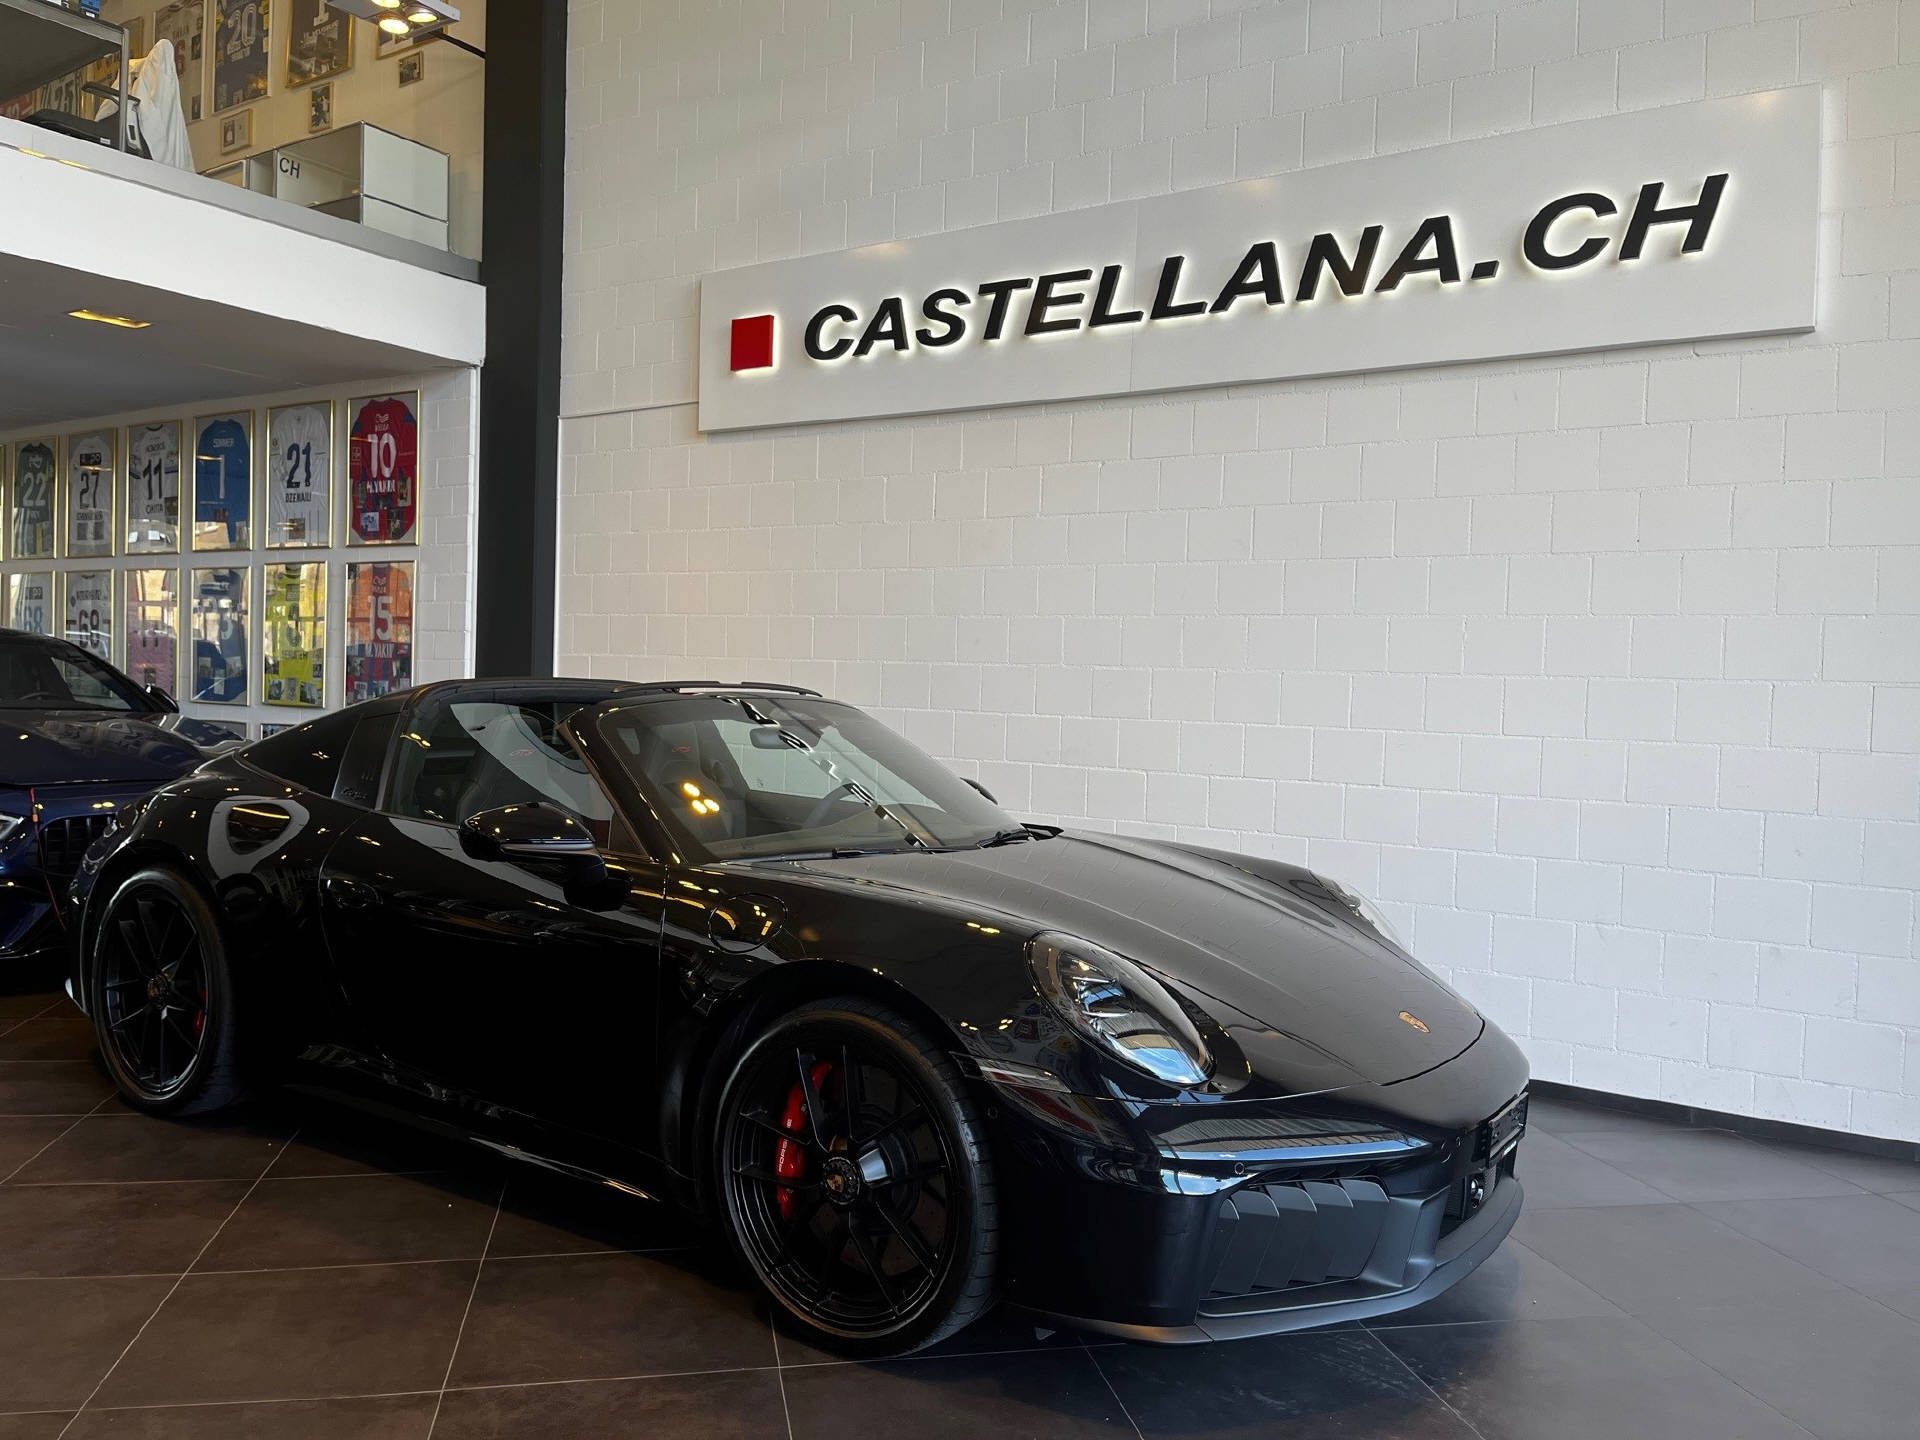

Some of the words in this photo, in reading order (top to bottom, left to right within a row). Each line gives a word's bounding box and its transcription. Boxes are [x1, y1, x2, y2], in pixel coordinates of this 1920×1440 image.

[227, 3, 256, 54] 20
[279, 157, 301, 179] CH
[805, 173, 1728, 361] CASTELLANA.CH
[286, 442, 312, 489] 21
[368, 433, 397, 478] 10
[22, 472, 47, 507] 22
[79, 471, 100, 509] 27
[142, 458, 162, 500] 11
[367, 595, 394, 641] 15
